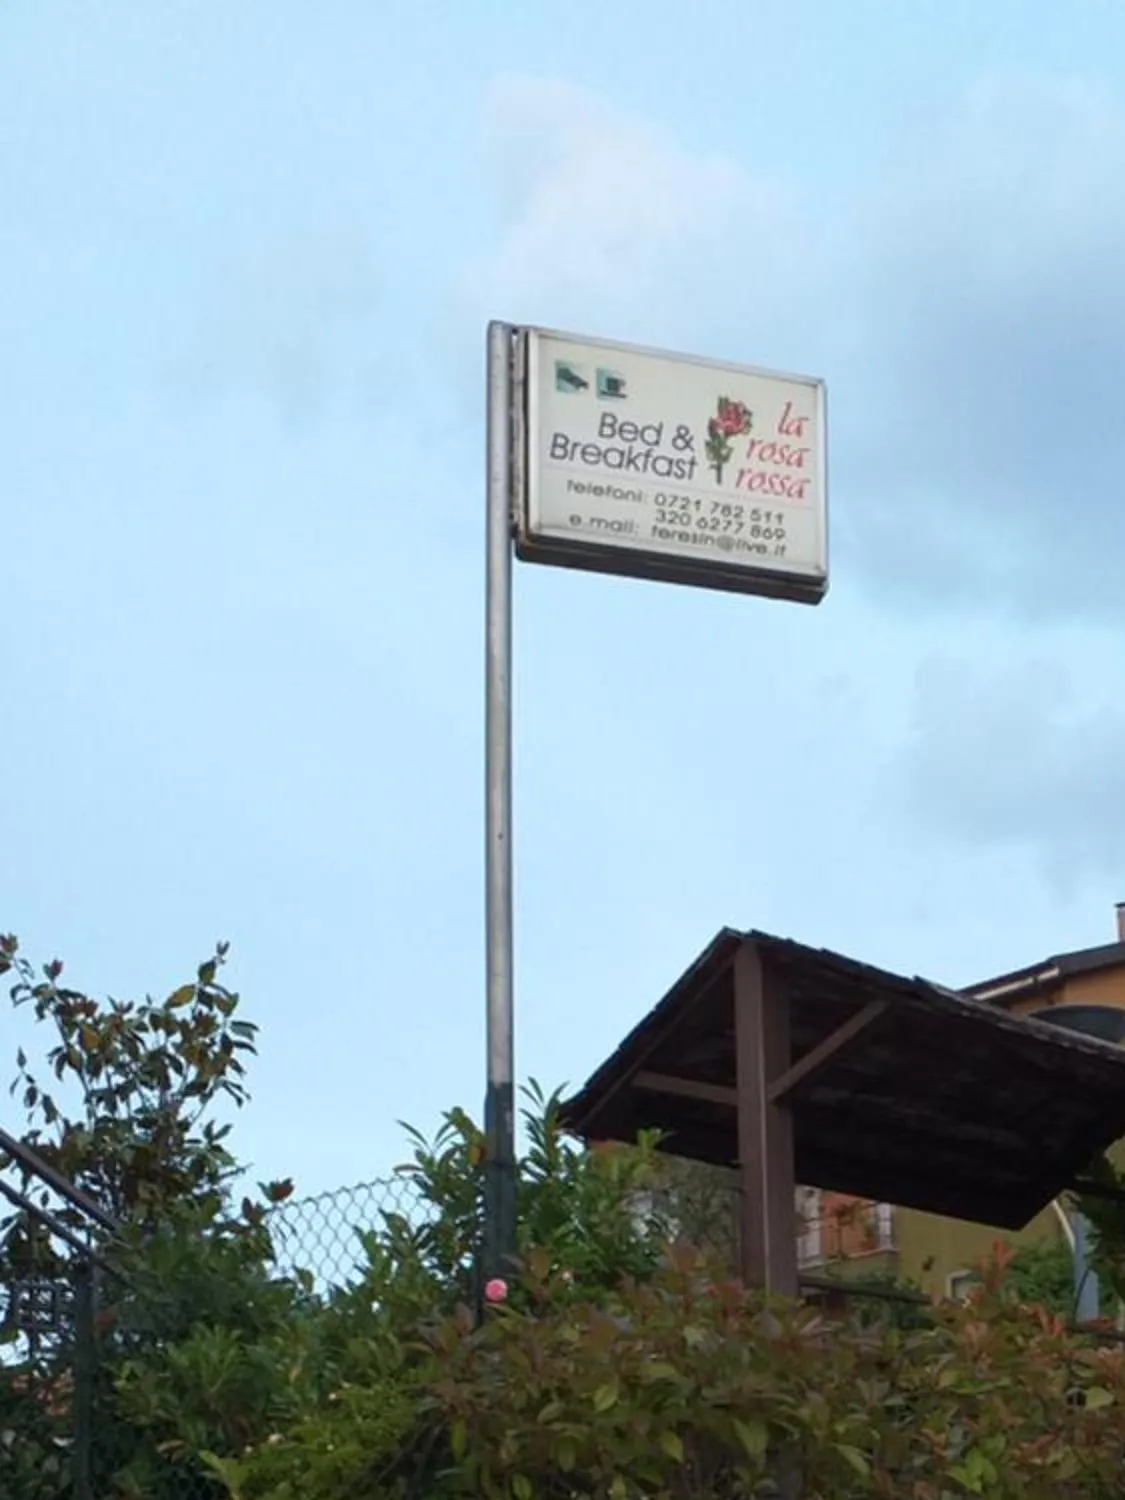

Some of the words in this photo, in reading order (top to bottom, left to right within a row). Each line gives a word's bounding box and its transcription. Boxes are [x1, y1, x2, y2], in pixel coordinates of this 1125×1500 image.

[599, 411, 663, 446] Bed
[672, 425, 695, 452] &
[778, 401, 810, 437] la
[549, 432, 698, 480] Breakfast
[746, 437, 810, 468] rosa
[735, 467, 811, 499] rossa
[654, 492, 701, 511] 0721
[710, 501, 744, 518] 782
[751, 508, 784, 525] 511
[656, 509, 692, 526] 320
[697, 517, 744, 534] 6277
[751, 525, 786, 541] 869
